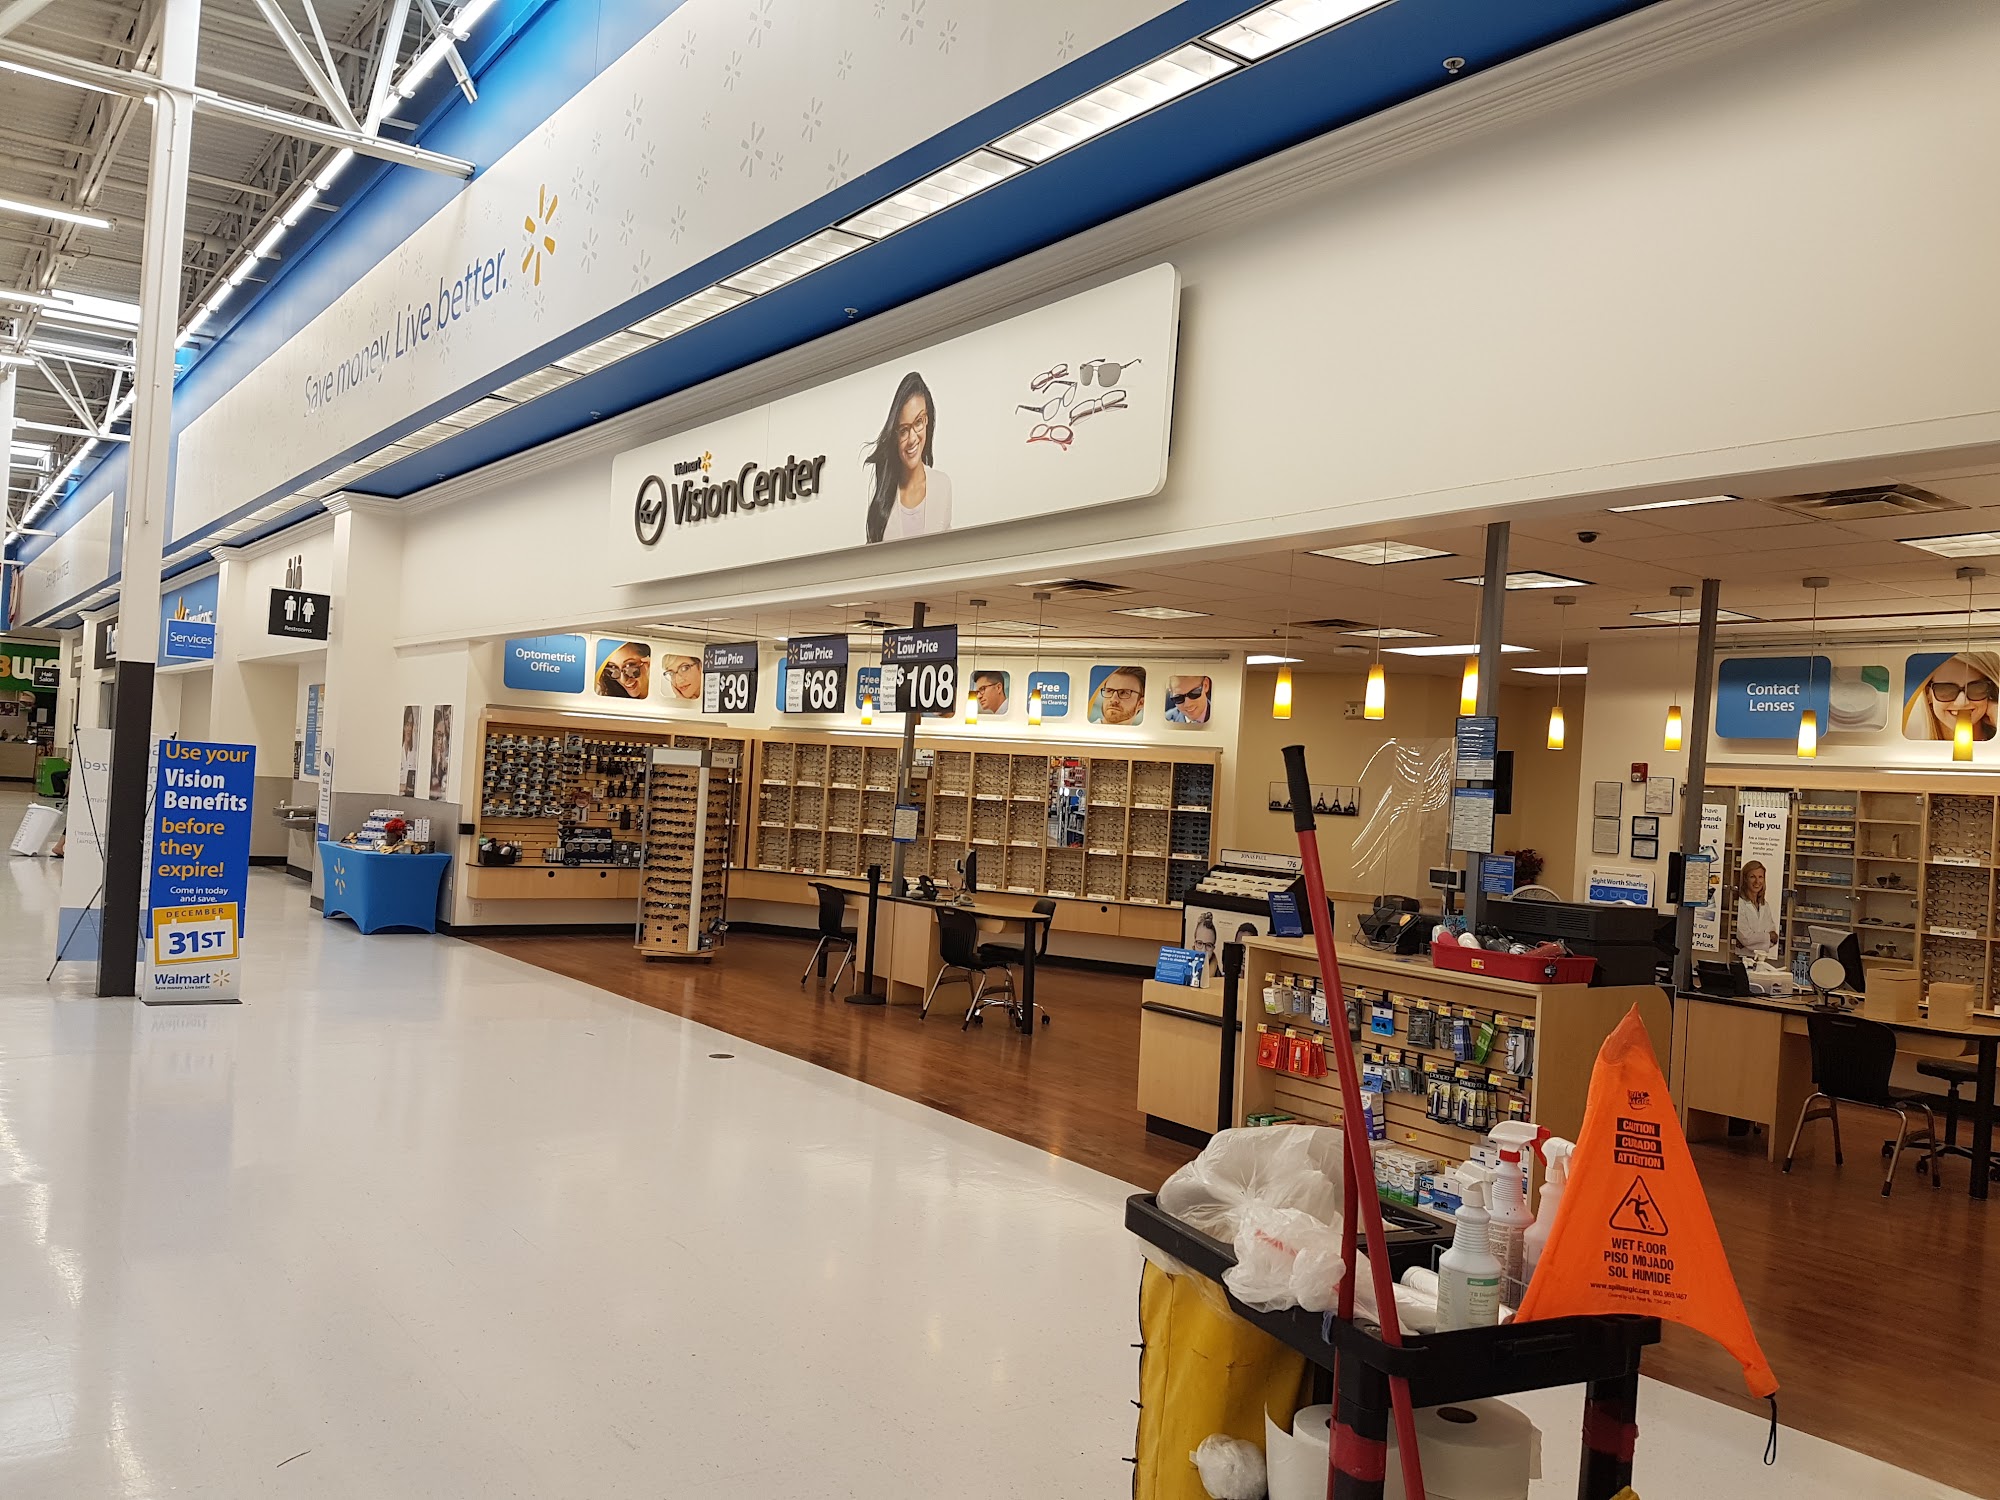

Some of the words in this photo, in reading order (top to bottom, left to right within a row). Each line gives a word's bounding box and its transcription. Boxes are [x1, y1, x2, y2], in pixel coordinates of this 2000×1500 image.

[304, 375, 334, 417] Save
[336, 330, 391, 396] money.
[395, 303, 432, 359] Live
[437, 248, 507, 331] better.
[673, 457, 702, 475] Walmart
[284, 625, 312, 633] Restrooms
[170, 631, 213, 645] Services
[898, 634, 914, 642] Everyday
[799, 649, 815, 661] Low
[815, 646, 834, 659] Price
[897, 642, 915, 655] Low
[916, 639, 939, 653] Price
[515, 648, 576, 663] Optometrist
[714, 654, 728, 665] Low
[727, 652, 744, 664] Price
[530, 661, 561, 673] Office
[860, 675, 880, 684] Free
[896, 664, 954, 709] $108
[719, 673, 749, 710] $39
[804, 669, 838, 709] $68
[1036, 682, 1060, 692] Free
[1746, 683, 1800, 695] Contact
[1749, 699, 1795, 711] Lenses
[165, 743, 202, 760] Use
[205, 749, 250, 765] your
[165, 768, 225, 789] Vision
[163, 790, 248, 812] Benefits
[1754, 810, 1767, 818] Let
[162, 817, 225, 835] before
[1748, 820, 1765, 830] help
[160, 839, 205, 860] they
[158, 861, 224, 881] expire!
[1607, 878, 1625, 886] Worth
[1625, 880, 1648, 889] Sharing
[170, 886, 195, 894] Come
[205, 888, 229, 896] today
[166, 907, 225, 918] DECEMBER
[168, 930, 226, 955] 31ST
[1702, 932, 1714, 940] Day
[1696, 941, 1716, 949] Prices.
[155, 973, 211, 985] Walmart
[1622, 1120, 1655, 1135] CAUTION
[1611, 1237, 1635, 1250] WET
[1603, 1250, 1629, 1264] PISO
[1632, 1254, 1674, 1271] MOJADO
[1608, 1265, 1629, 1279] SOL
[1632, 1268, 1671, 1285] HUMIDE
